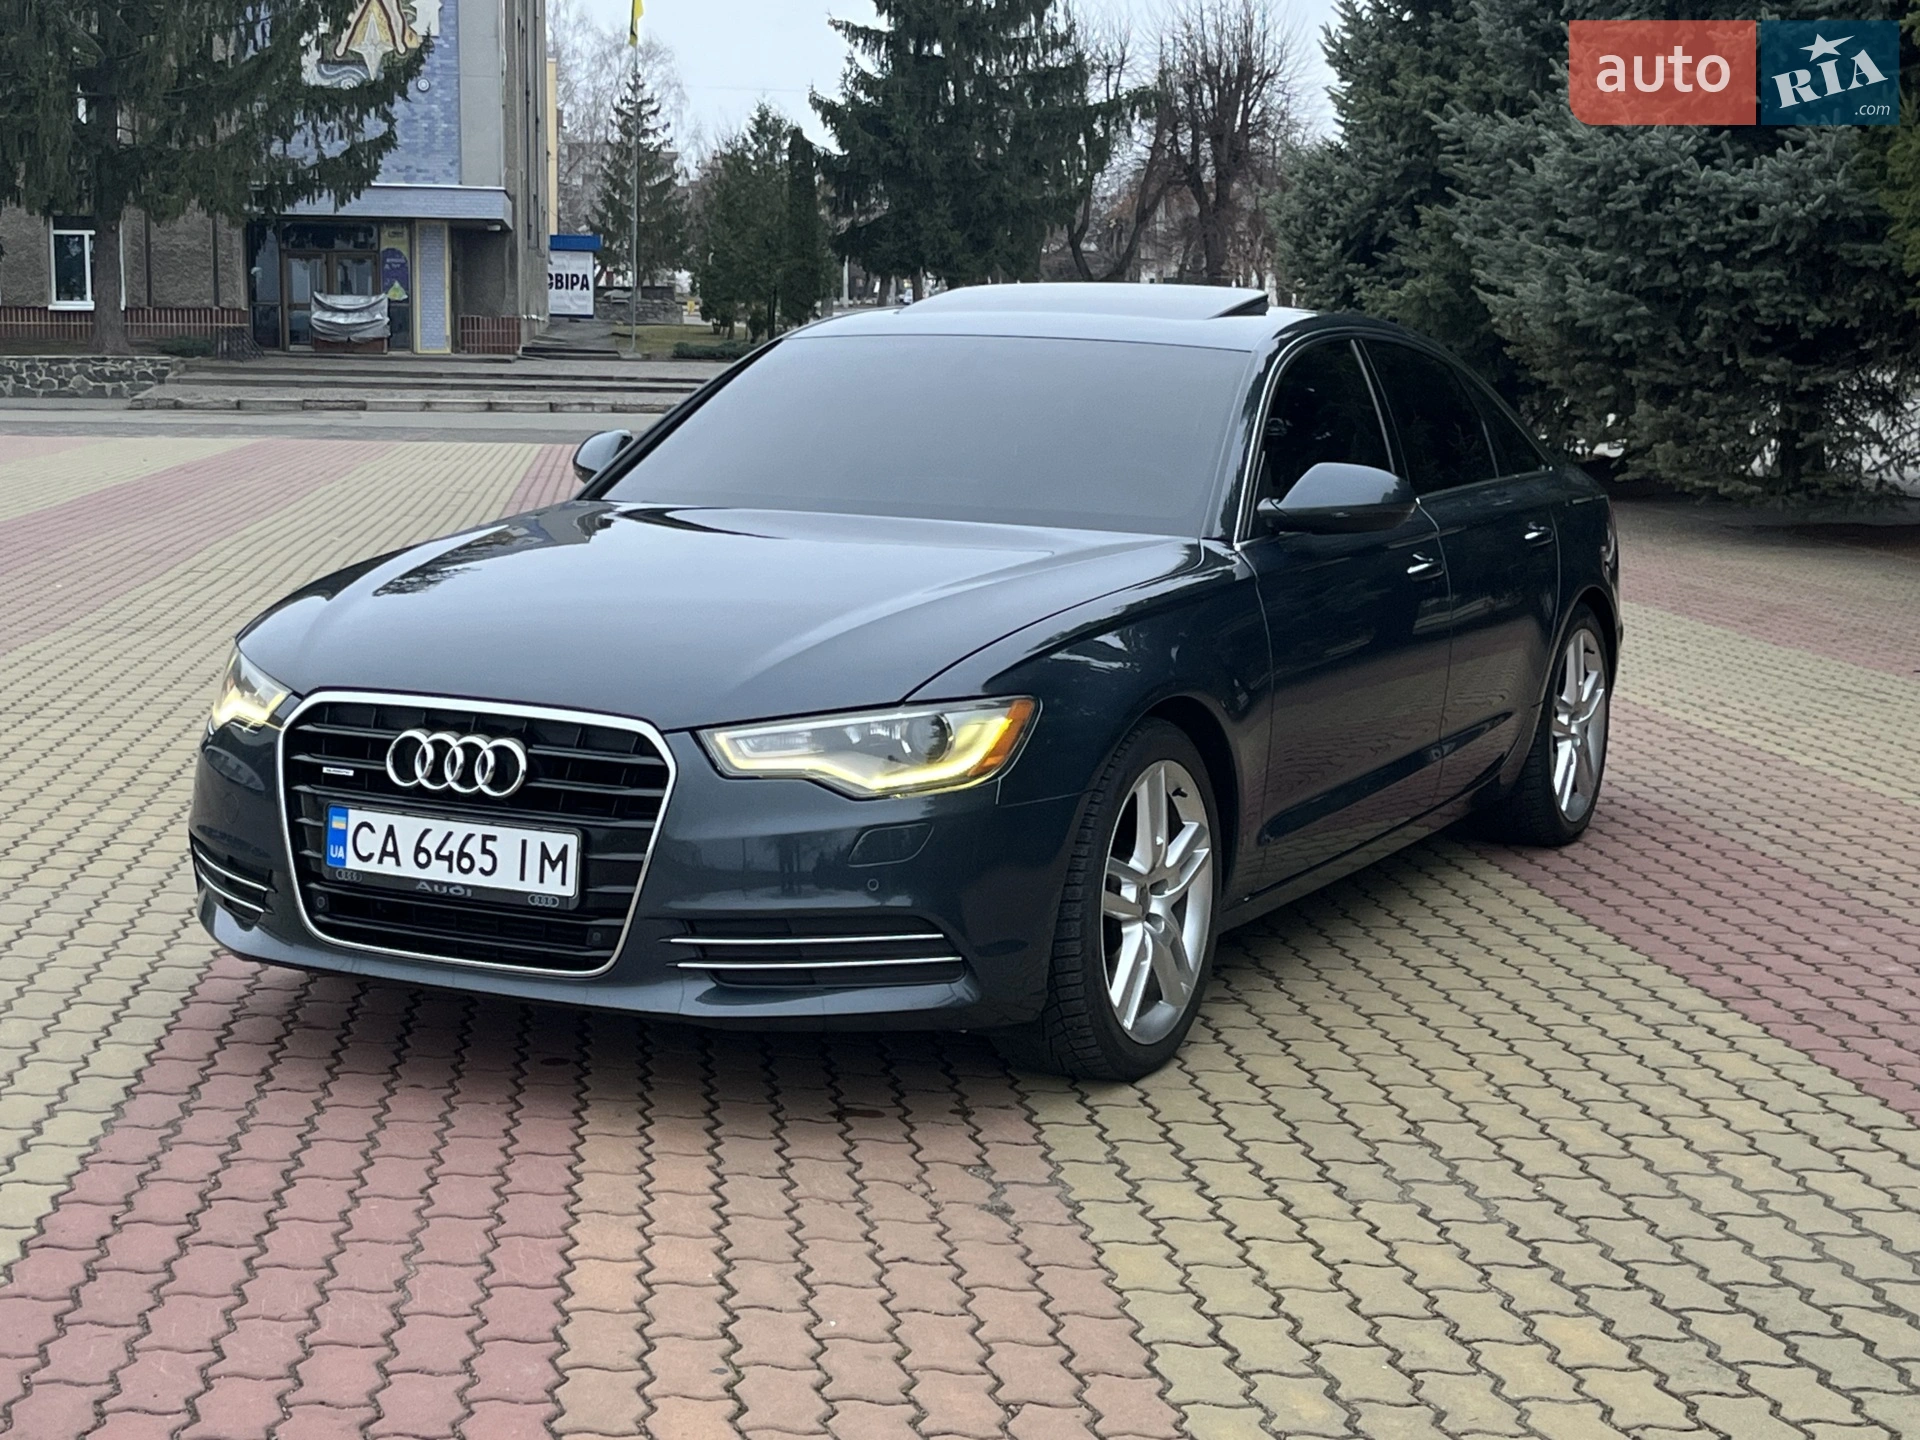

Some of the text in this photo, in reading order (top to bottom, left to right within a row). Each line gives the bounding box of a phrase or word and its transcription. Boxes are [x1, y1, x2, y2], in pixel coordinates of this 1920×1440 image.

[330, 845, 345, 860] UA
[351, 821, 569, 887] CA 6465 IM
